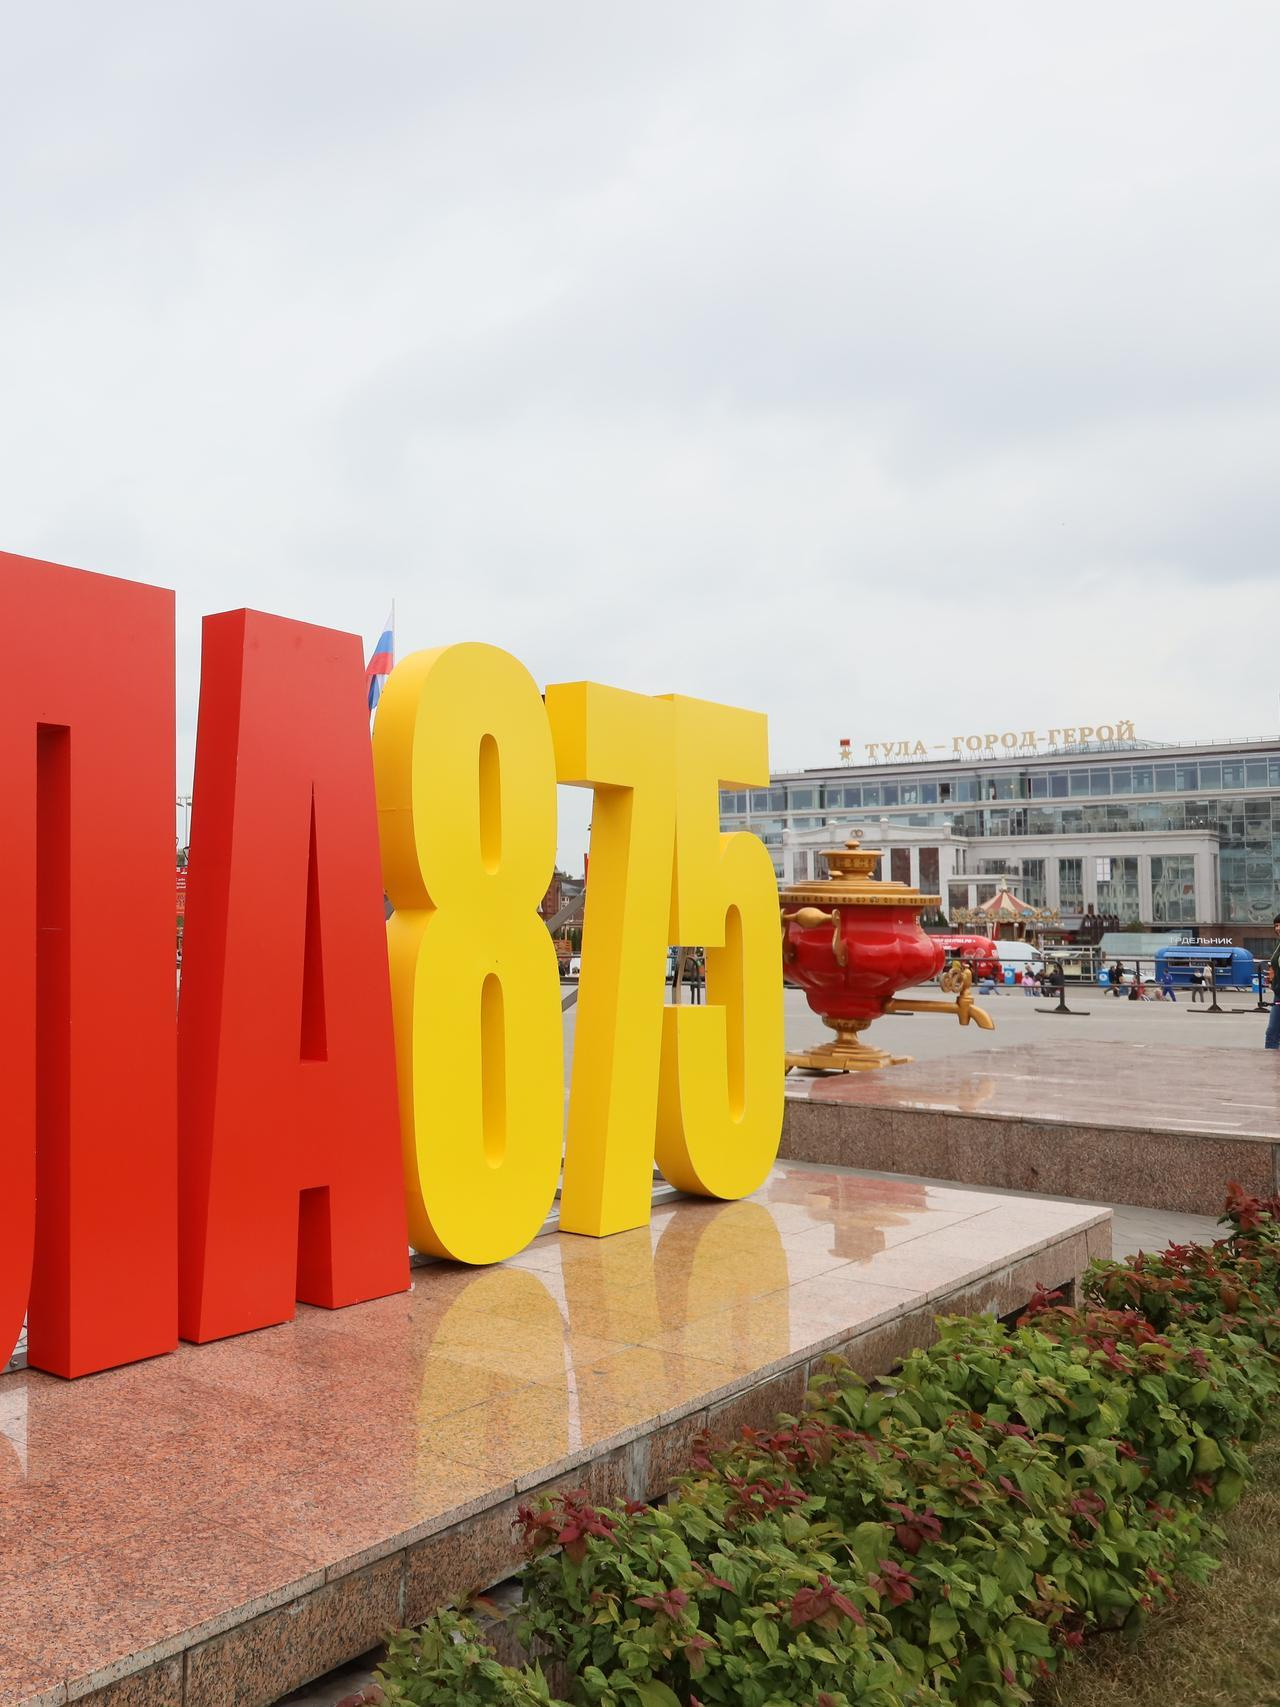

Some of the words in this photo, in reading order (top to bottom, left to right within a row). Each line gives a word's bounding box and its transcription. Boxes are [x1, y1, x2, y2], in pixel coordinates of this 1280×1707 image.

[864, 740, 928, 759] ТУЛА
[951, 720, 1136, 753] ГОРОД-ГЕРОЙ
[373, 642, 785, 1267] 875
